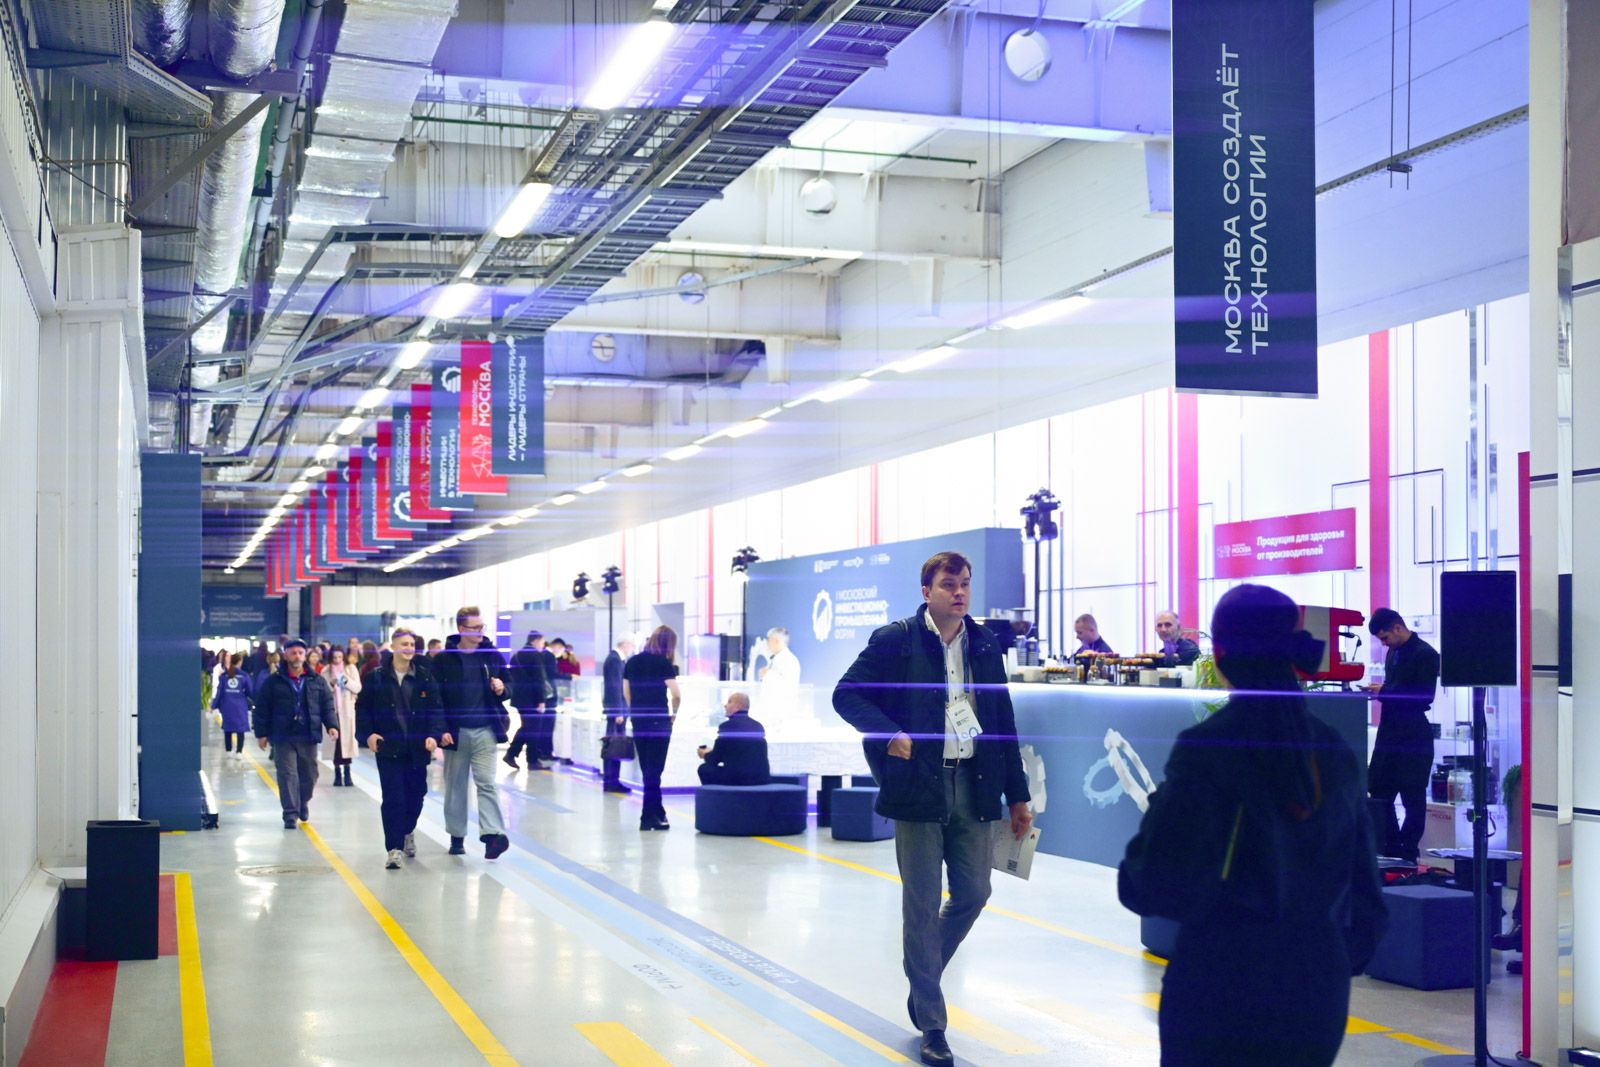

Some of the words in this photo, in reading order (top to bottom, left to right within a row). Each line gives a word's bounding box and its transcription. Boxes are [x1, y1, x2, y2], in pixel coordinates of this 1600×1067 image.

[1215, 43, 1242, 205] СОЗДАЁТ
[1249, 134, 1269, 355] ТЕХНОЛОГИИ
[1223, 215, 1242, 354] МОСКВА
[479, 360, 492, 427] МОСКВА
[518, 355, 527, 402] СТРАНЫ
[508, 414, 517, 461] ЛИДЕРЫ
[518, 404, 527, 452] ЛИДЕРЫ
[1256, 535, 1295, 548] Продукция
[1295, 534, 1309, 544] для
[1310, 530, 1345, 542] здоровья
[1257, 552, 1265, 560] от
[1265, 544, 1324, 561] производителей
